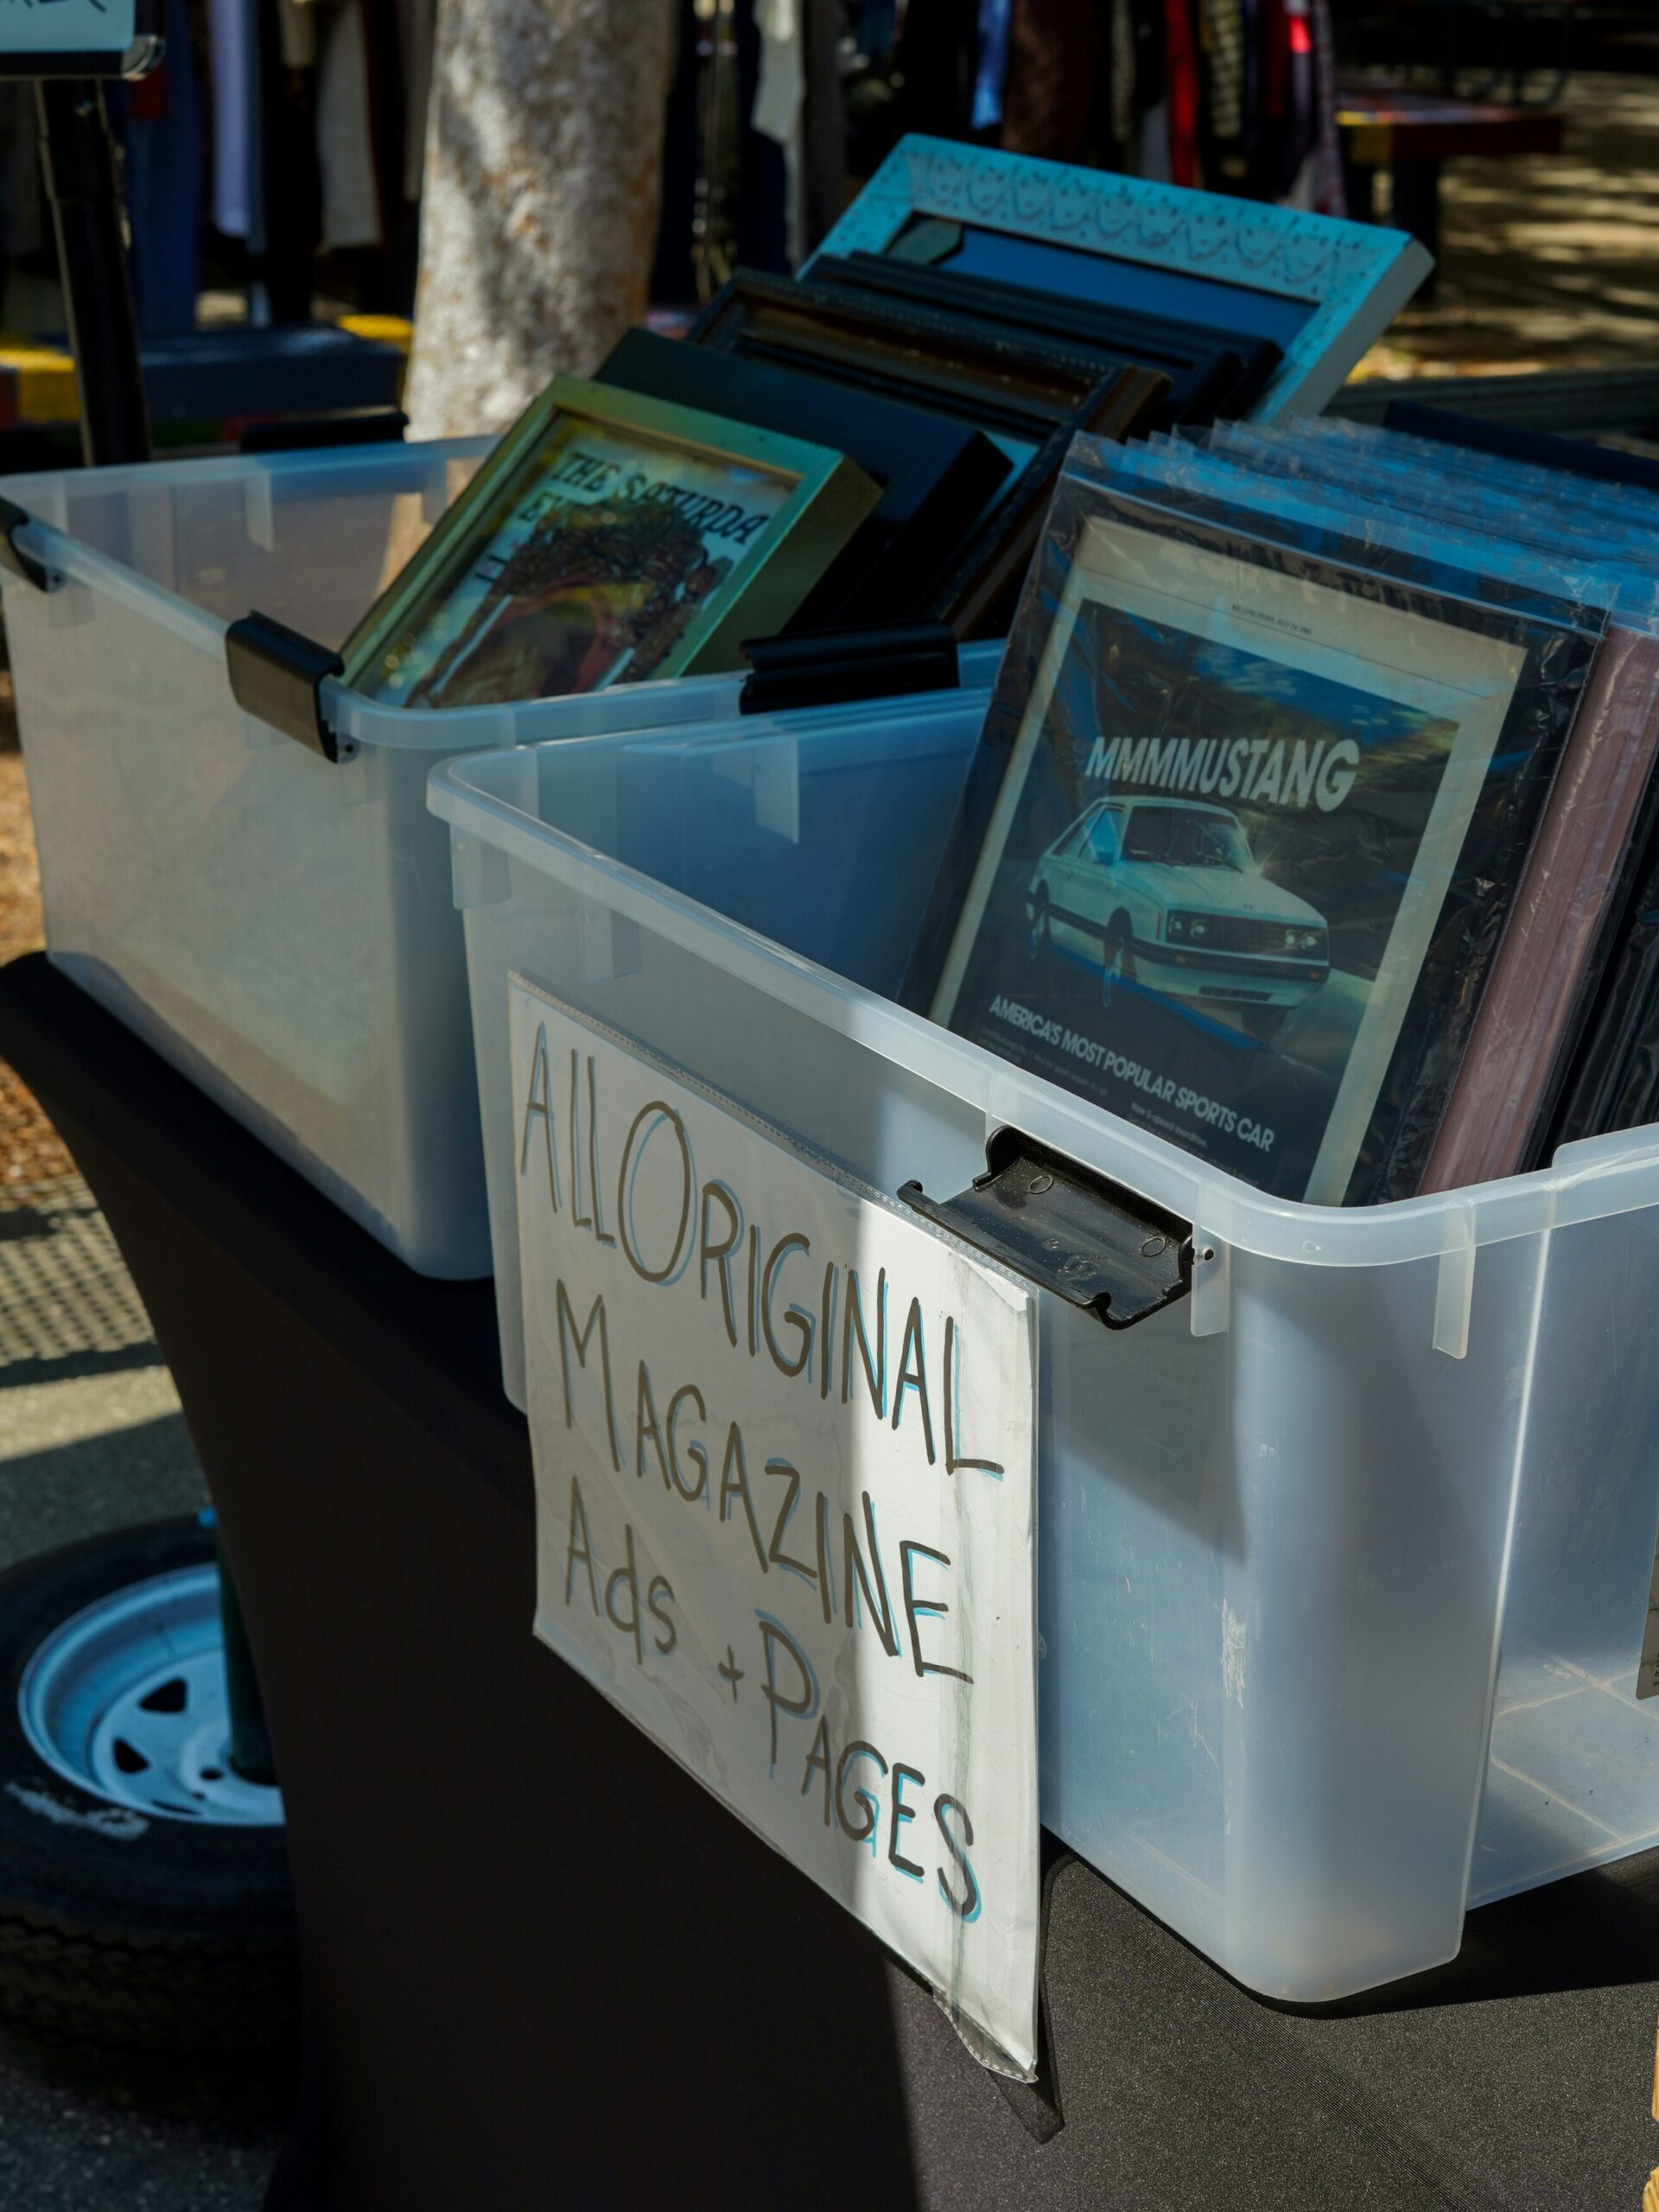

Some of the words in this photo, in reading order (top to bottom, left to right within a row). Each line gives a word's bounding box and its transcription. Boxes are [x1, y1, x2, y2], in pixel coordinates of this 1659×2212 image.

[550, 450, 620, 493] THE
[1084, 734, 1361, 812] MMMMUSTANG
[989, 995, 1063, 1046] AMERICA'S
[1061, 1029, 1107, 1068] MOST
[1103, 1050, 1177, 1104] POPULAR
[1174, 1084, 1238, 1134] SPORTS
[1237, 1118, 1275, 1152] CAR
[619, 1101, 1005, 1476] ORIGINAL
[556, 1279, 974, 1683] MAGAZINE
[565, 1476, 677, 1663] Ads
[757, 1609, 981, 1922] PAGES
